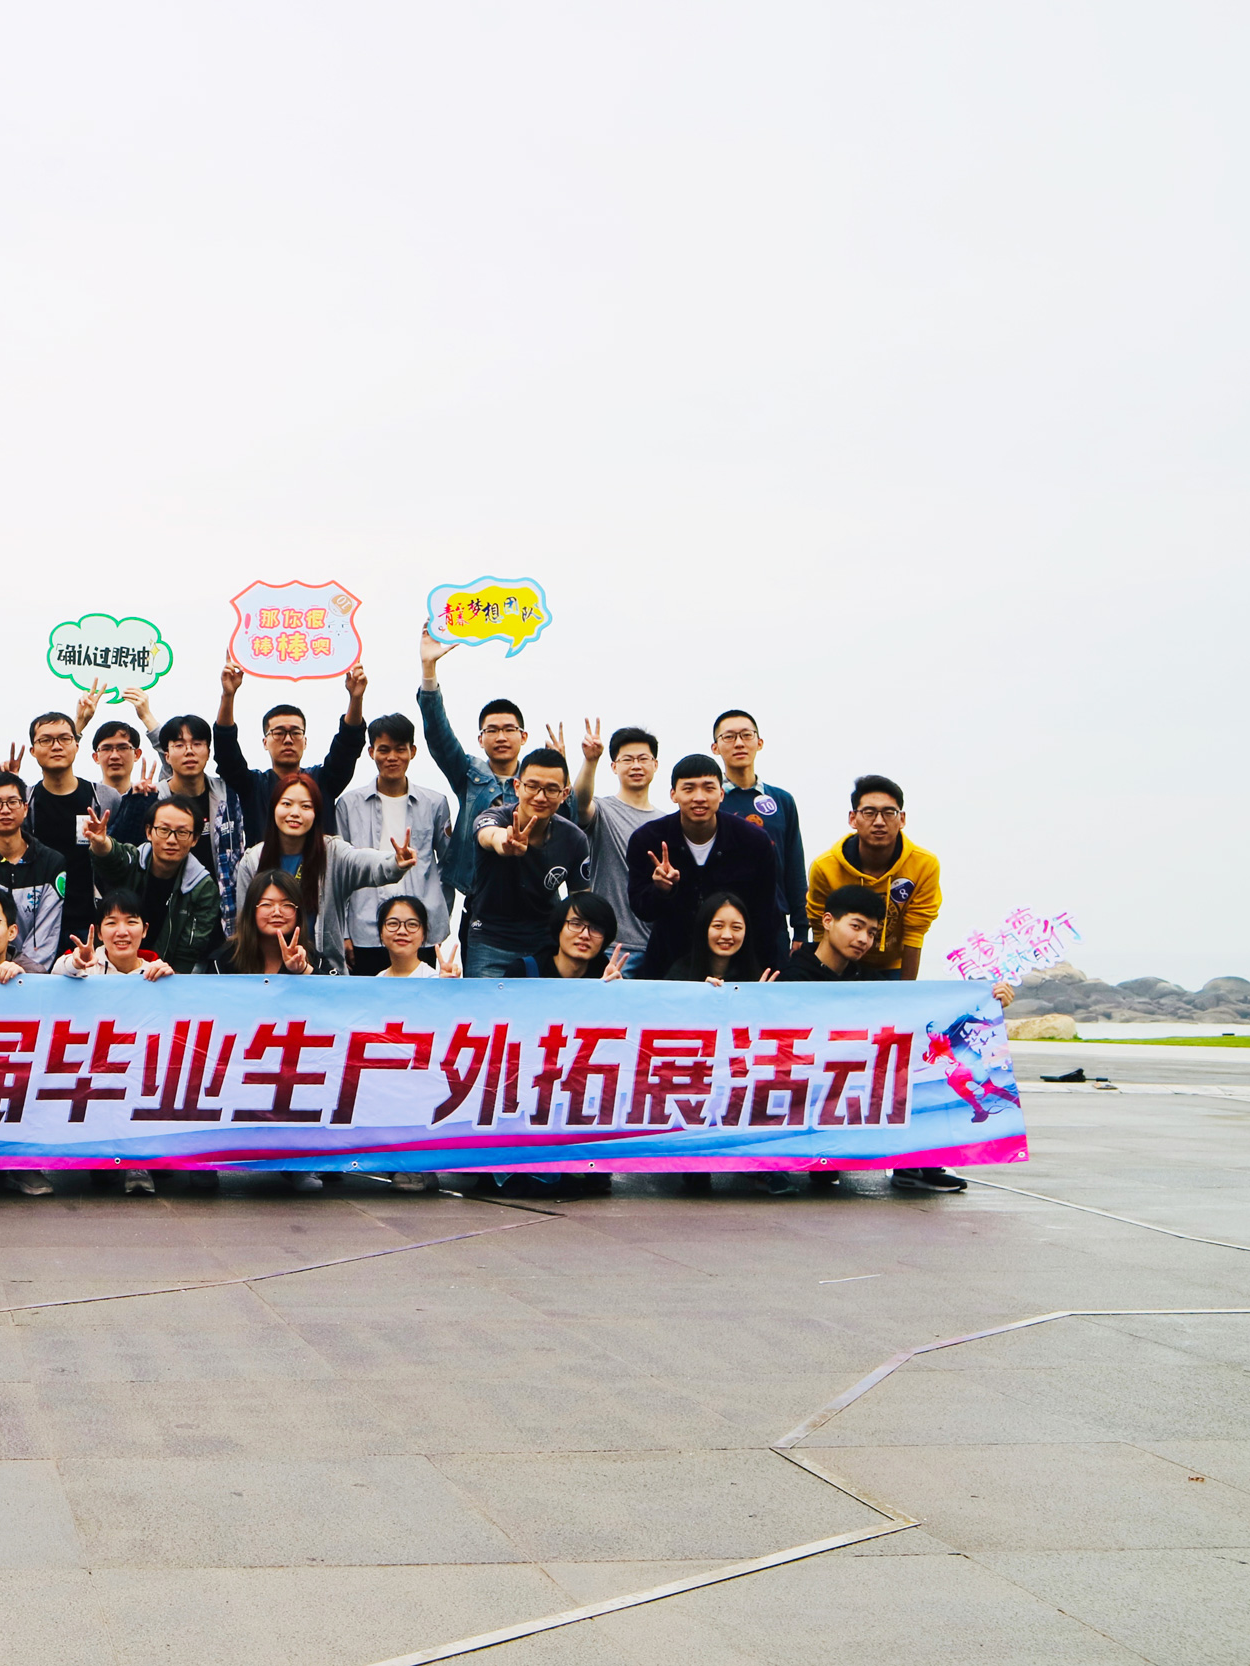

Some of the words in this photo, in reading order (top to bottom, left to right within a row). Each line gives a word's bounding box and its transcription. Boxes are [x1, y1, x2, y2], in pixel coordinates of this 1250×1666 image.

[259, 608, 326, 629] 那你很
[438, 596, 542, 627] 青春梦想团队
[760, 801, 775, 813] 10
